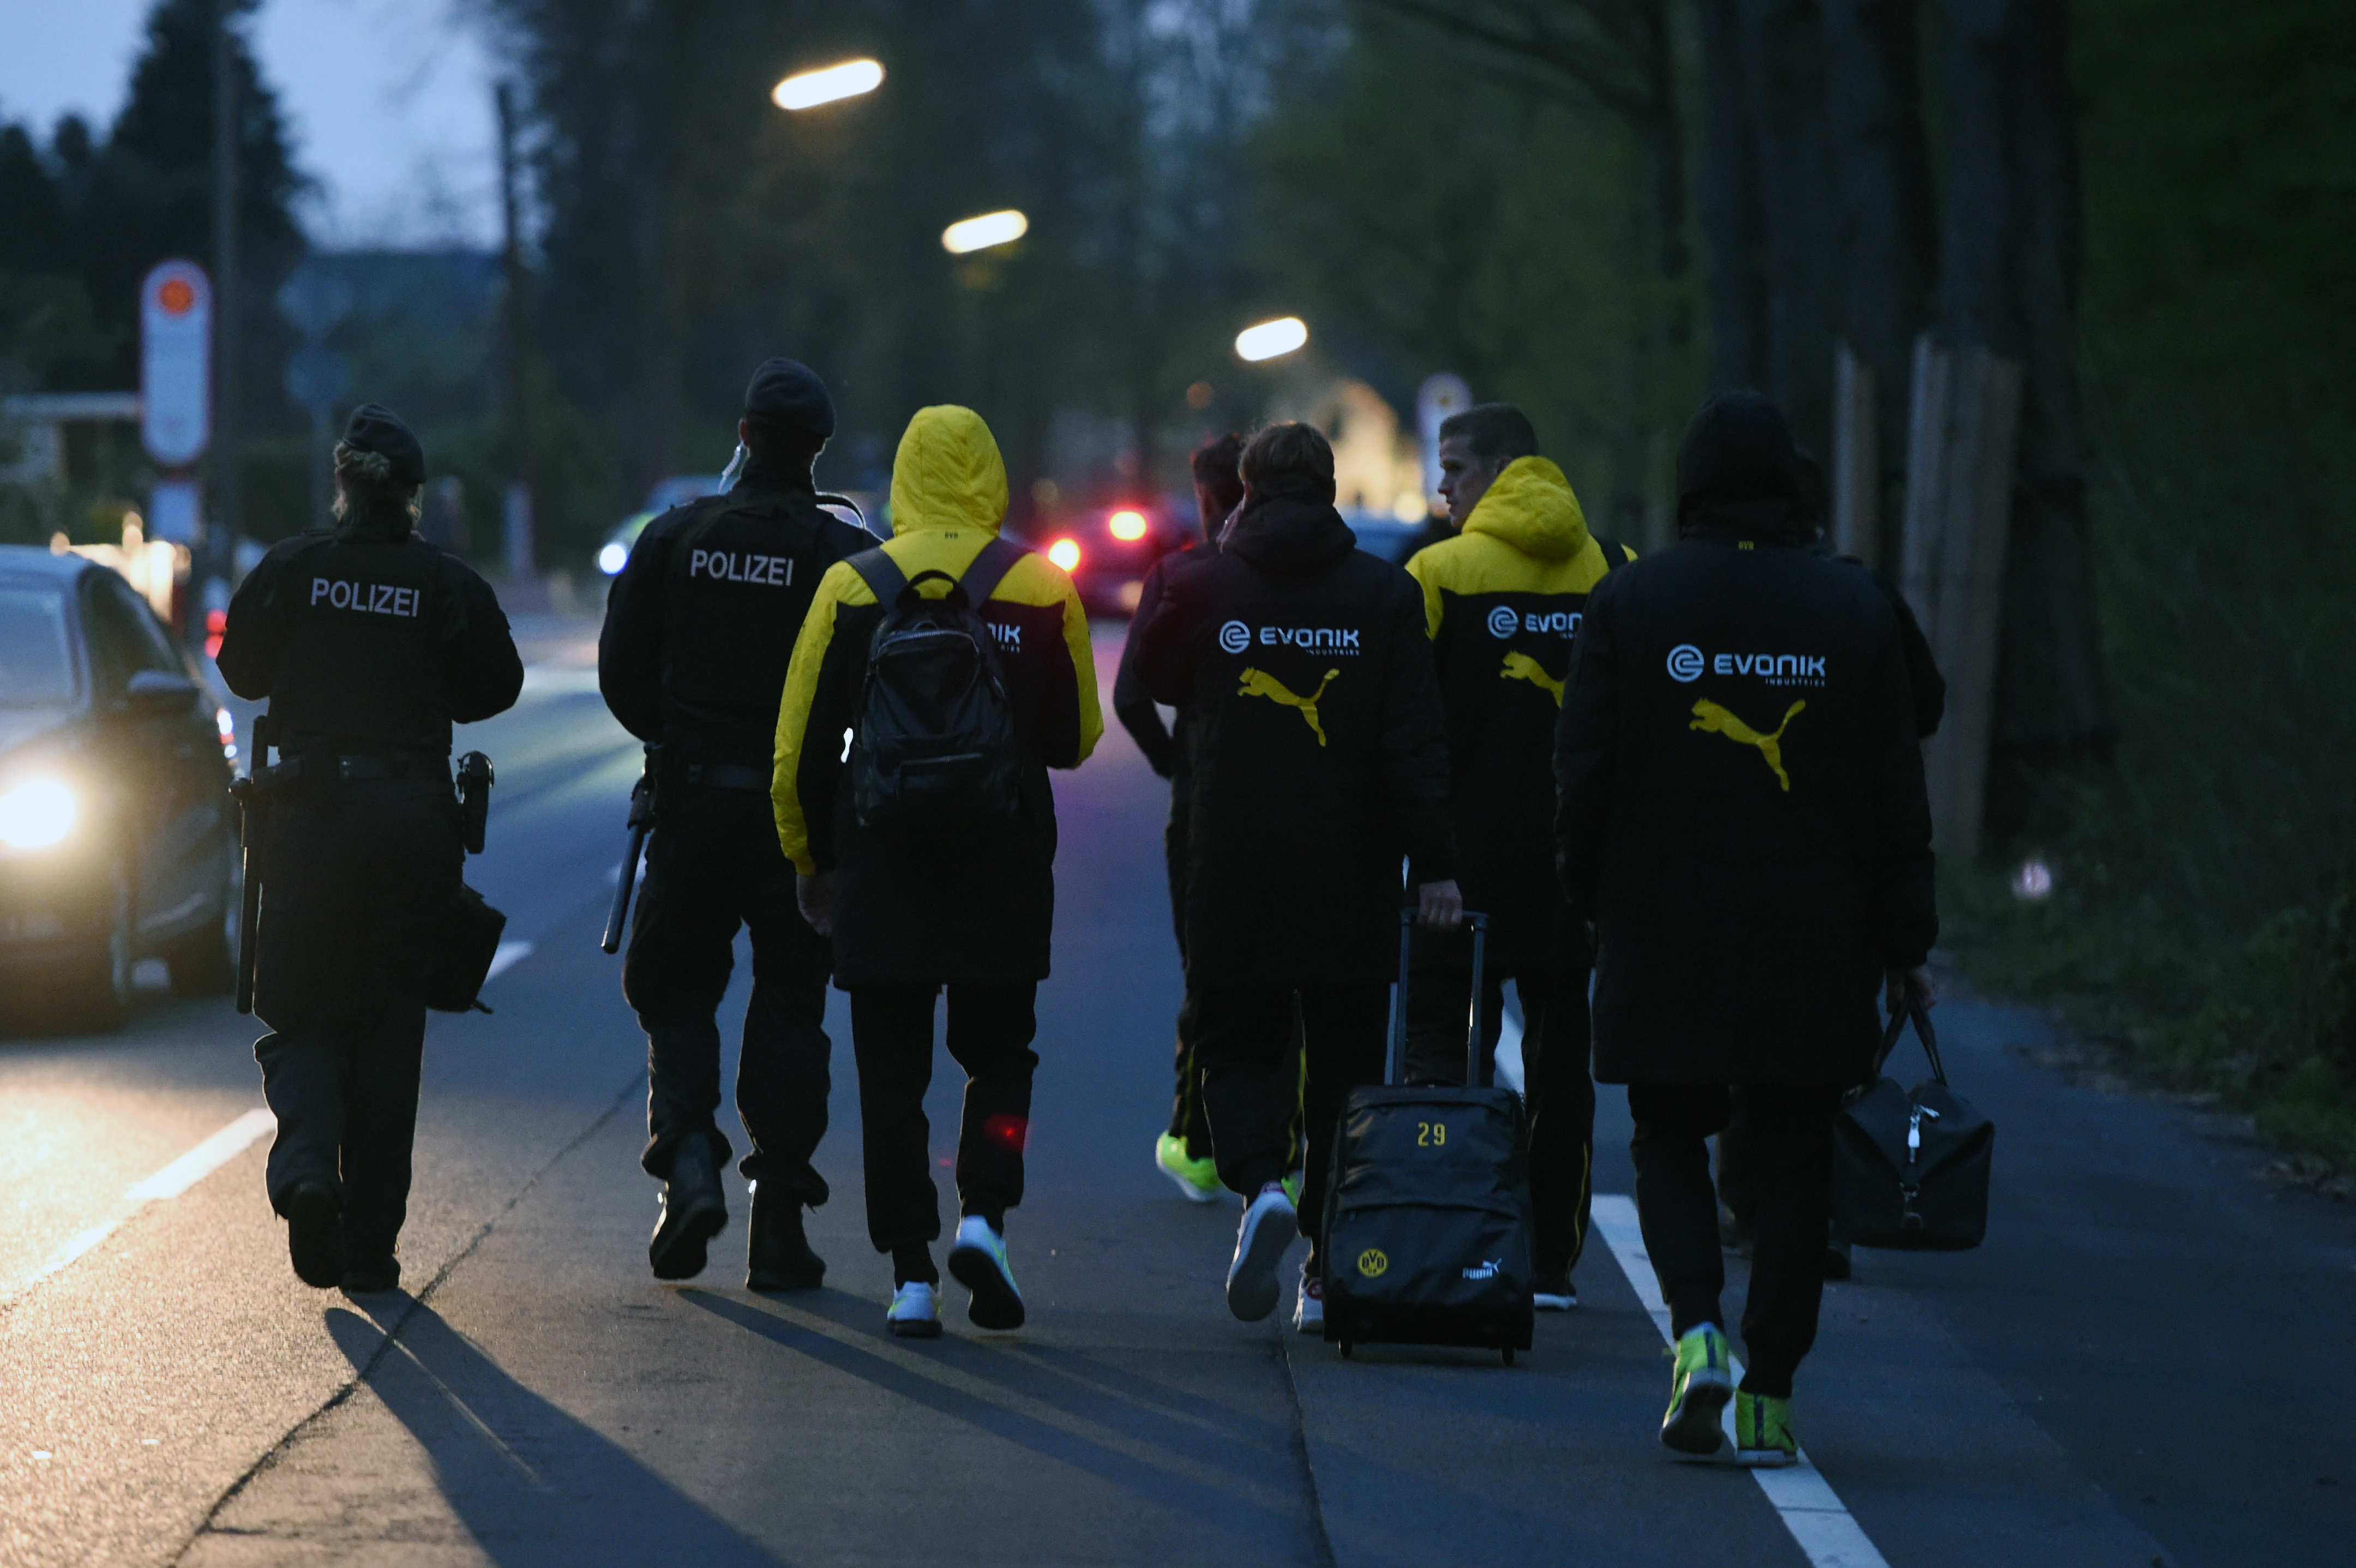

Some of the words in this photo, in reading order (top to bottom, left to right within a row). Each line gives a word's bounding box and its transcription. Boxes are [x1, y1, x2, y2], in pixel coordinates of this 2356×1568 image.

[689, 548, 794, 587] POLIZEI
[310, 577, 420, 618] POLIZEI
[987, 622, 1021, 645] NIK
[1525, 611, 1583, 633] EVON
[1259, 626, 1360, 648] EVONIK
[1714, 653, 1826, 677] EVONIK
[1764, 676, 1826, 687] INDUSTRIES
[1417, 1121, 1446, 1147] 29
